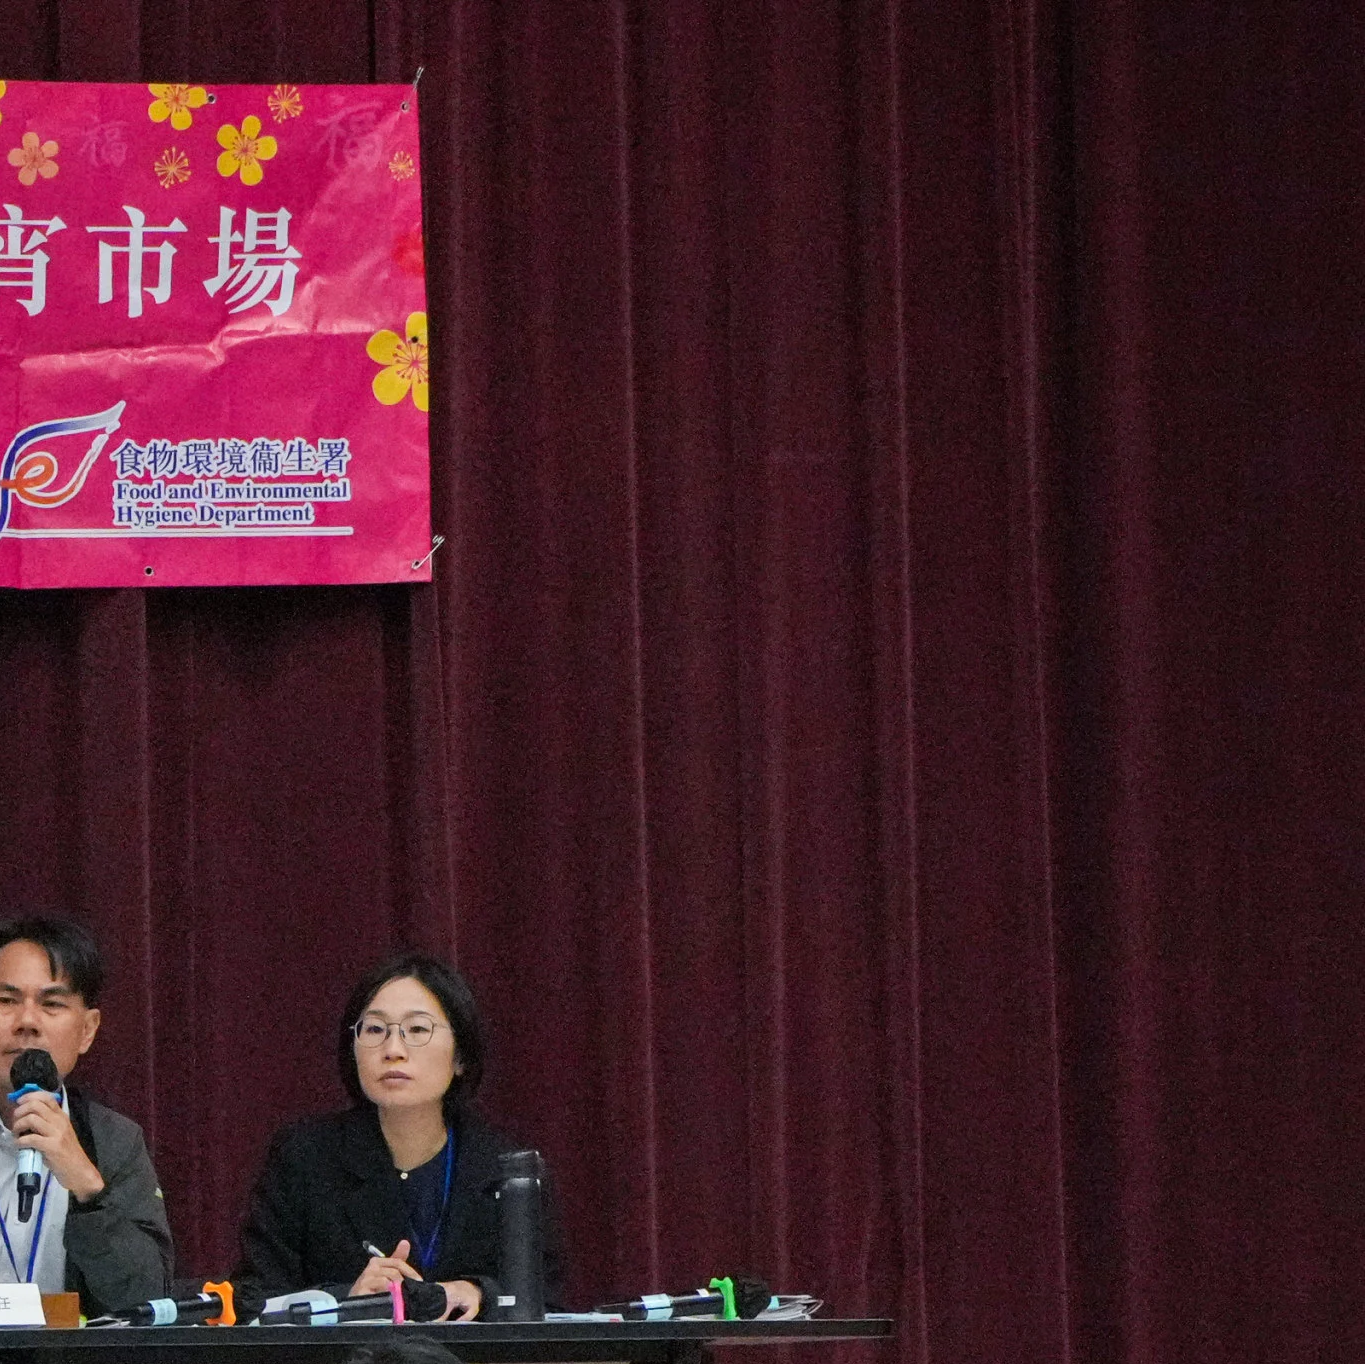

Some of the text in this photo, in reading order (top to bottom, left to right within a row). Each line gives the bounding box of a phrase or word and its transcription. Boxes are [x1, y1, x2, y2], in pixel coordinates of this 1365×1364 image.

[117, 481, 347, 500] Food and Environmental
[117, 504, 312, 527] Hygiene Department
